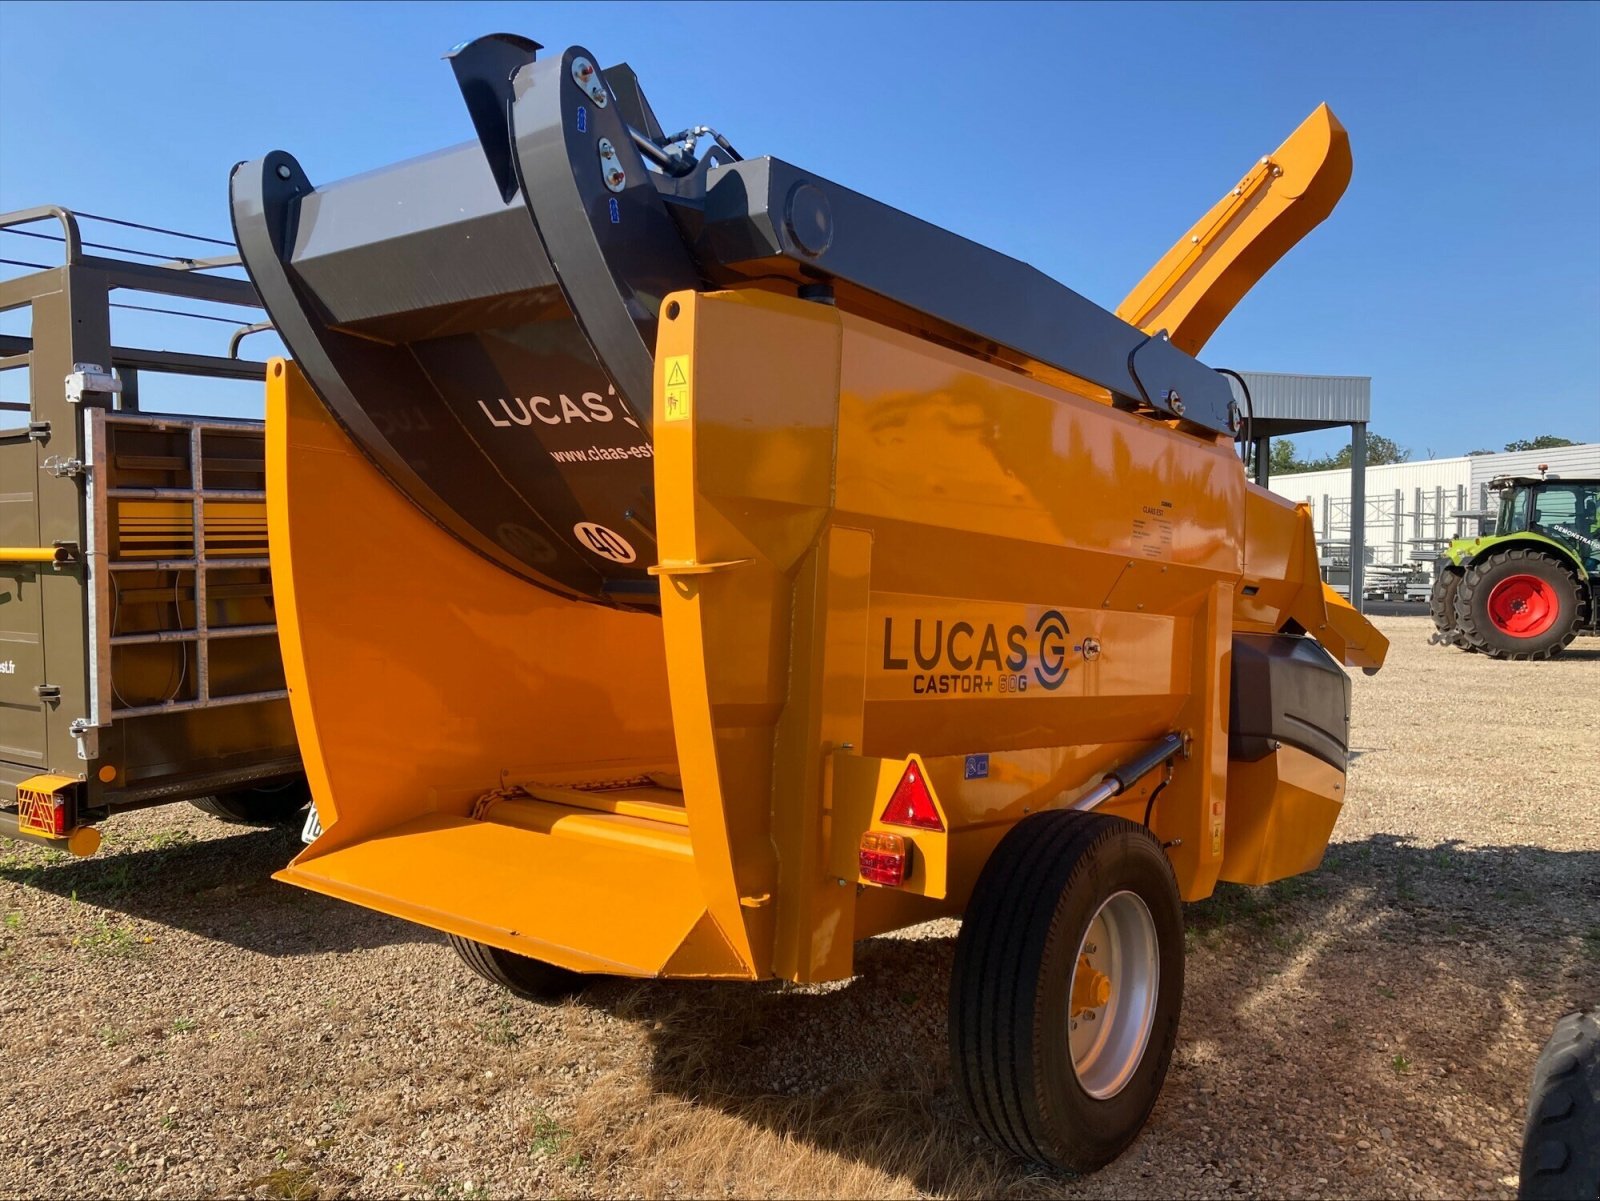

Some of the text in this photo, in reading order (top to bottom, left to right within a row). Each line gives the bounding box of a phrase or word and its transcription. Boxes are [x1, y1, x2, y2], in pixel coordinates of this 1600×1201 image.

[477, 392, 614, 427] LUCAS
[581, 526, 631, 560] 40
[883, 617, 1028, 671] LUCAS
[913, 674, 1028, 694] CASTOR+ 60G
